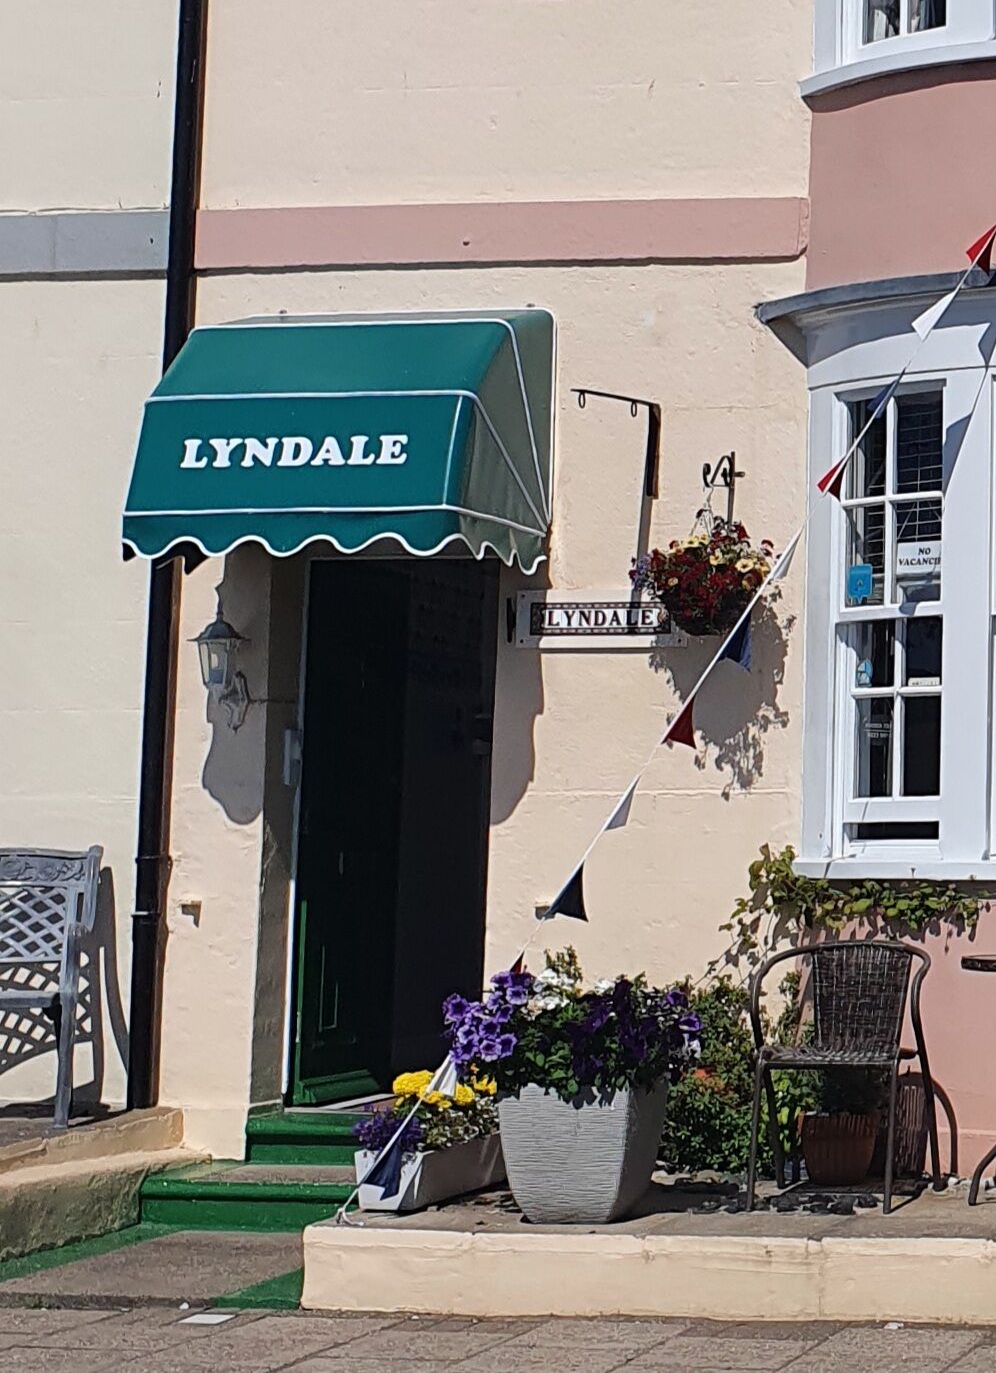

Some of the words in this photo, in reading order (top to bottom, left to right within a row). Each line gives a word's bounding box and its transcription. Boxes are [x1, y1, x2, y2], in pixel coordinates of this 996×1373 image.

[179, 434, 409, 469] LYNDALE
[918, 547, 931, 556] NO
[547, 610, 654, 627] LYNDALE
